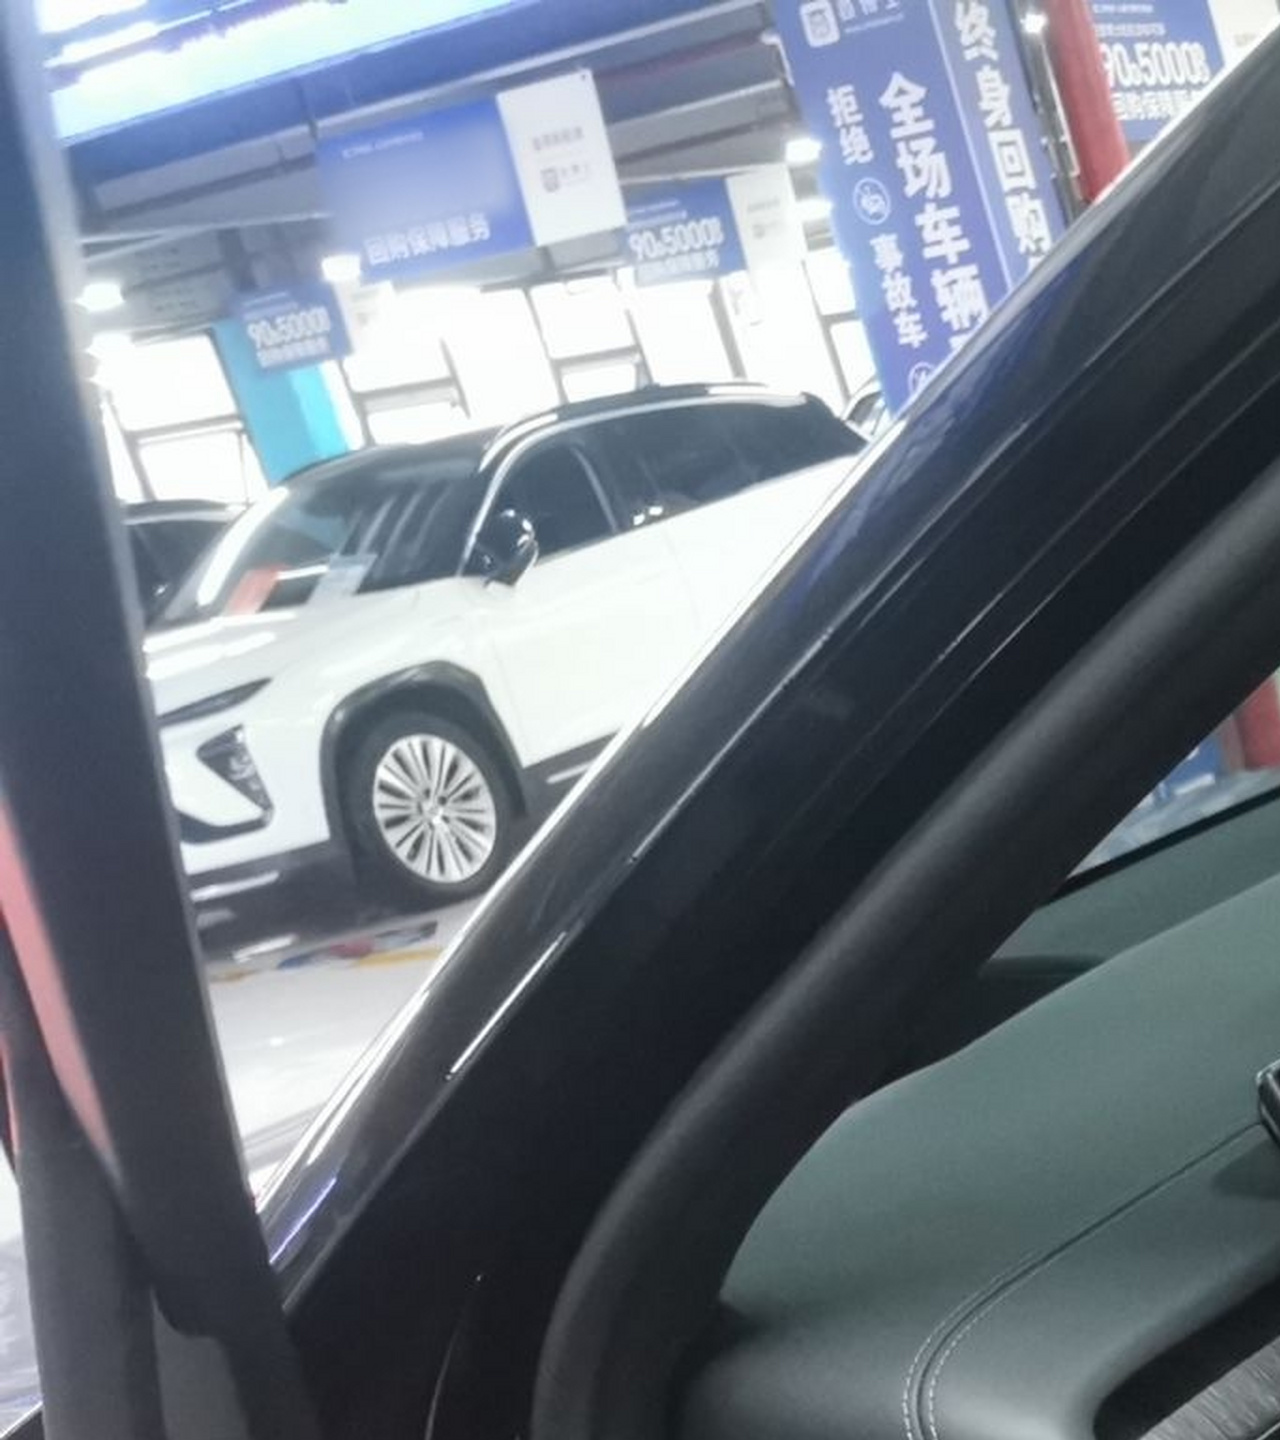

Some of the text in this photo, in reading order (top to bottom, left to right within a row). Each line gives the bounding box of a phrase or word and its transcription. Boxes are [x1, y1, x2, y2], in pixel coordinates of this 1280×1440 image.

[879, 71, 988, 350] 全场车辆
[956, 0, 1054, 280] 终身回购
